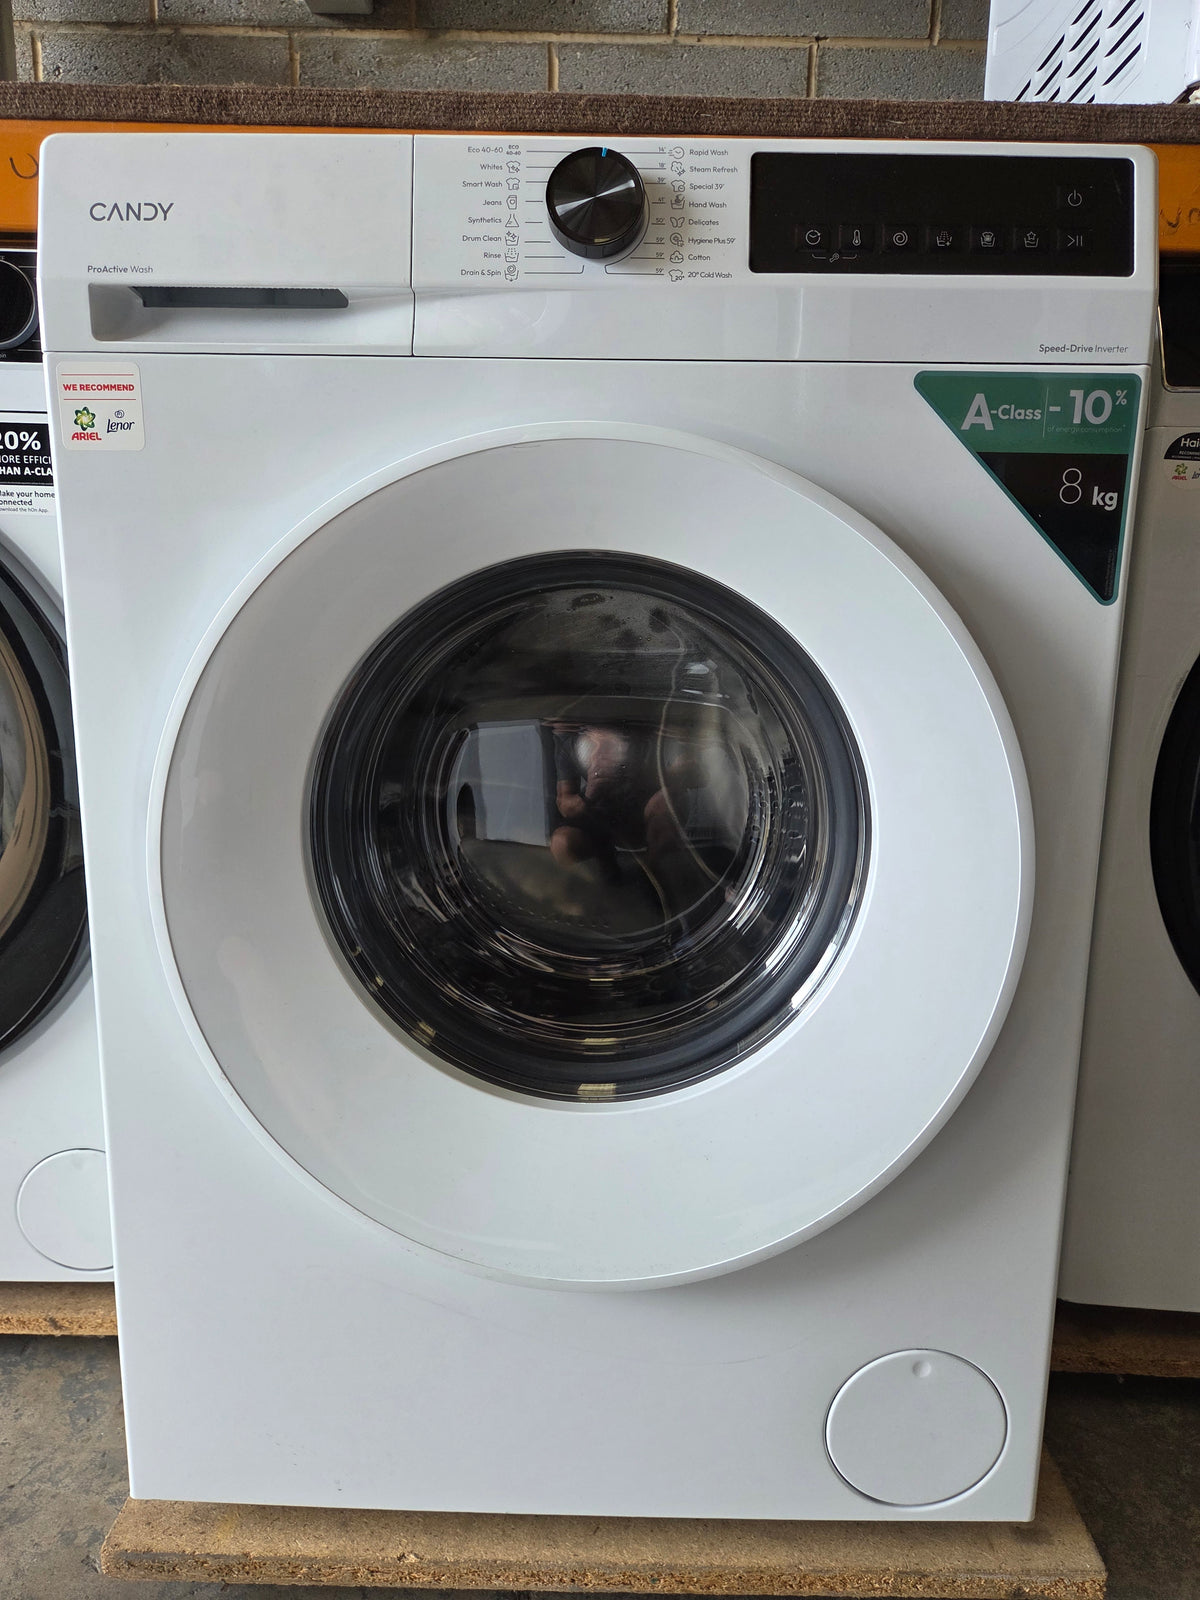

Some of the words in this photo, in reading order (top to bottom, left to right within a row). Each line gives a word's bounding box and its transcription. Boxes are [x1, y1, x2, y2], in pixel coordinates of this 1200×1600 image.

[480, 163, 503, 171] Whites
[712, 165, 738, 173] Refresh
[462, 180, 483, 188] Smart
[484, 180, 503, 188] Wash
[689, 183, 714, 191] Special
[89, 202, 174, 222] CANDY
[467, 216, 502, 224] Synthetics
[687, 237, 713, 245] Hygiene
[687, 253, 711, 261] Cotton
[87, 265, 129, 274] ProActive
[129, 265, 154, 274] Wash
[487, 269, 502, 278] Spin
[700, 271, 715, 279] Cold
[715, 271, 733, 279] Wash
[1039, 343, 1094, 355] Speed-Drive
[1094, 344, 1129, 354] Inverter
[62, 383, 78, 392] WE
[79, 383, 135, 392] RECOMMEND
[960, 393, 1042, 431] A-Class
[106, 418, 136, 434] Lenor
[71, 432, 102, 441] ARIEL
[1180, 437, 1200, 448] Hai
[0, 454, 21, 464] ORE
[1059, 468, 1082, 505] 8
[1092, 486, 1119, 511] kg
[0, 490, 15, 498] ake
[16, 491, 33, 499] your
[34, 491, 55, 499] home
